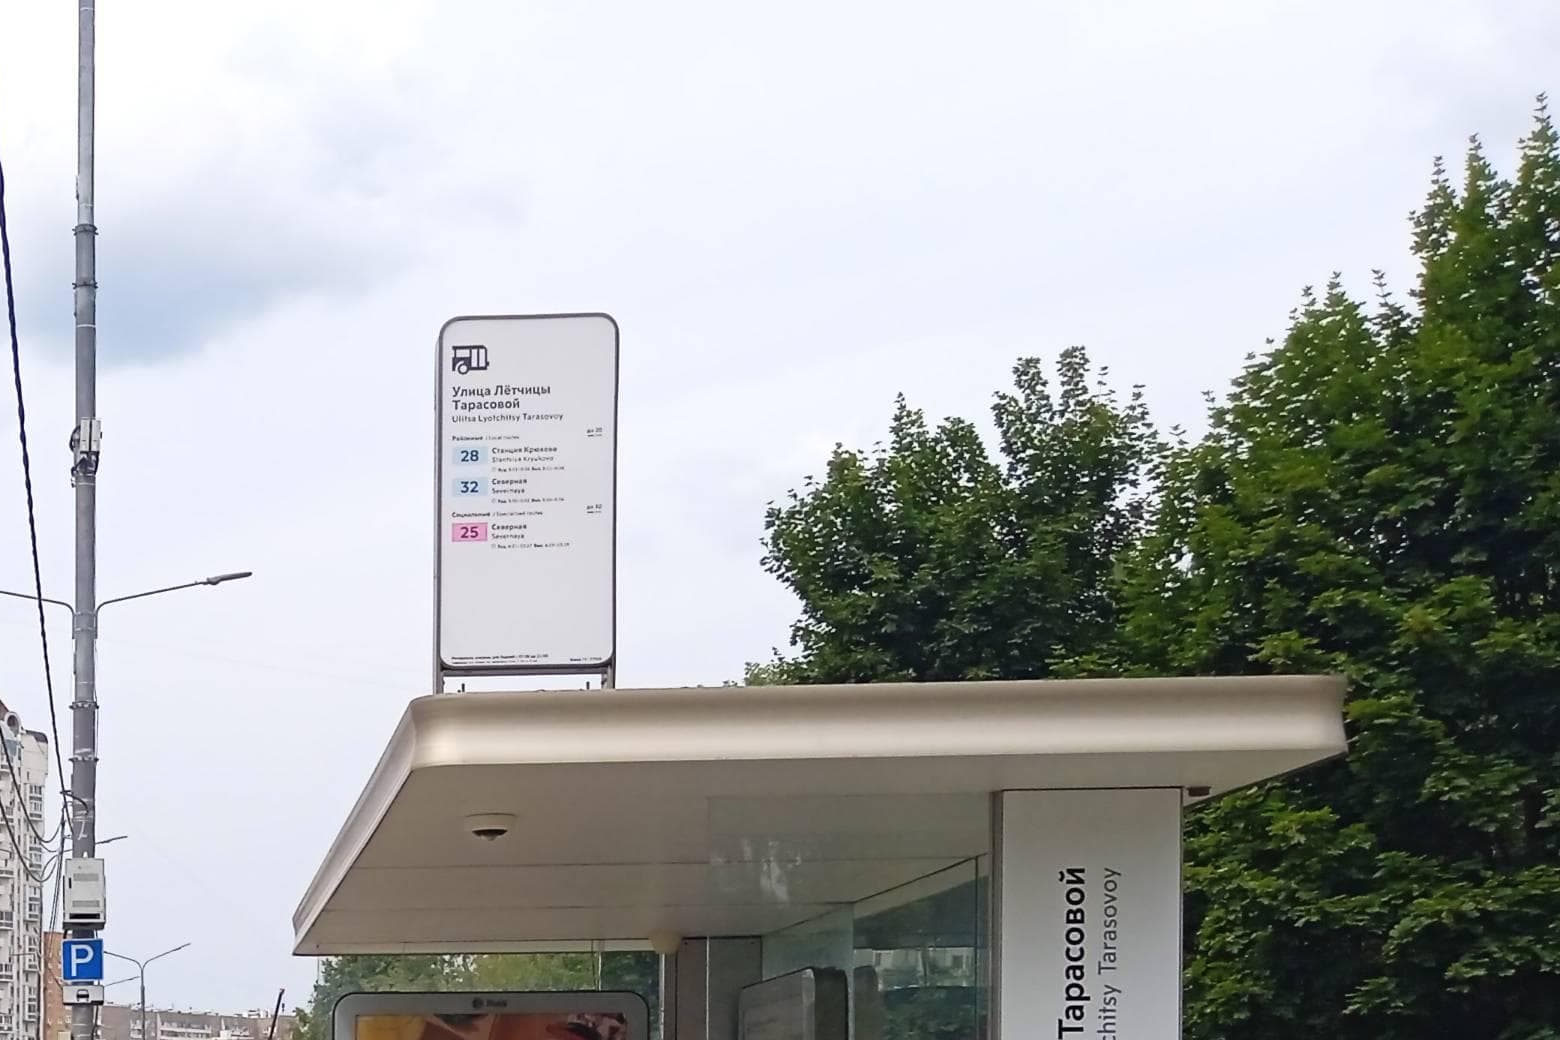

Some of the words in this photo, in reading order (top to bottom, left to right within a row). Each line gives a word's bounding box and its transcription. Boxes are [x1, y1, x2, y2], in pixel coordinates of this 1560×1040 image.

[452, 386, 491, 398] Улица
[494, 384, 551, 396] Лётчицы
[452, 398, 520, 413] Тарасовой
[452, 415, 476, 423] Ulitsa
[478, 414, 521, 423] Lyotchitsy
[522, 412, 564, 421] Tarasovoy
[460, 449, 479, 463] 28
[460, 480, 479, 494] 32
[491, 478, 528, 487] Северная
[460, 525, 479, 539] 25
[491, 523, 527, 532] Северная
[1097, 867, 1122, 976] Tarasovoy
[71, 944, 94, 977] P
[1057, 867, 1091, 1040] Тарасовой
